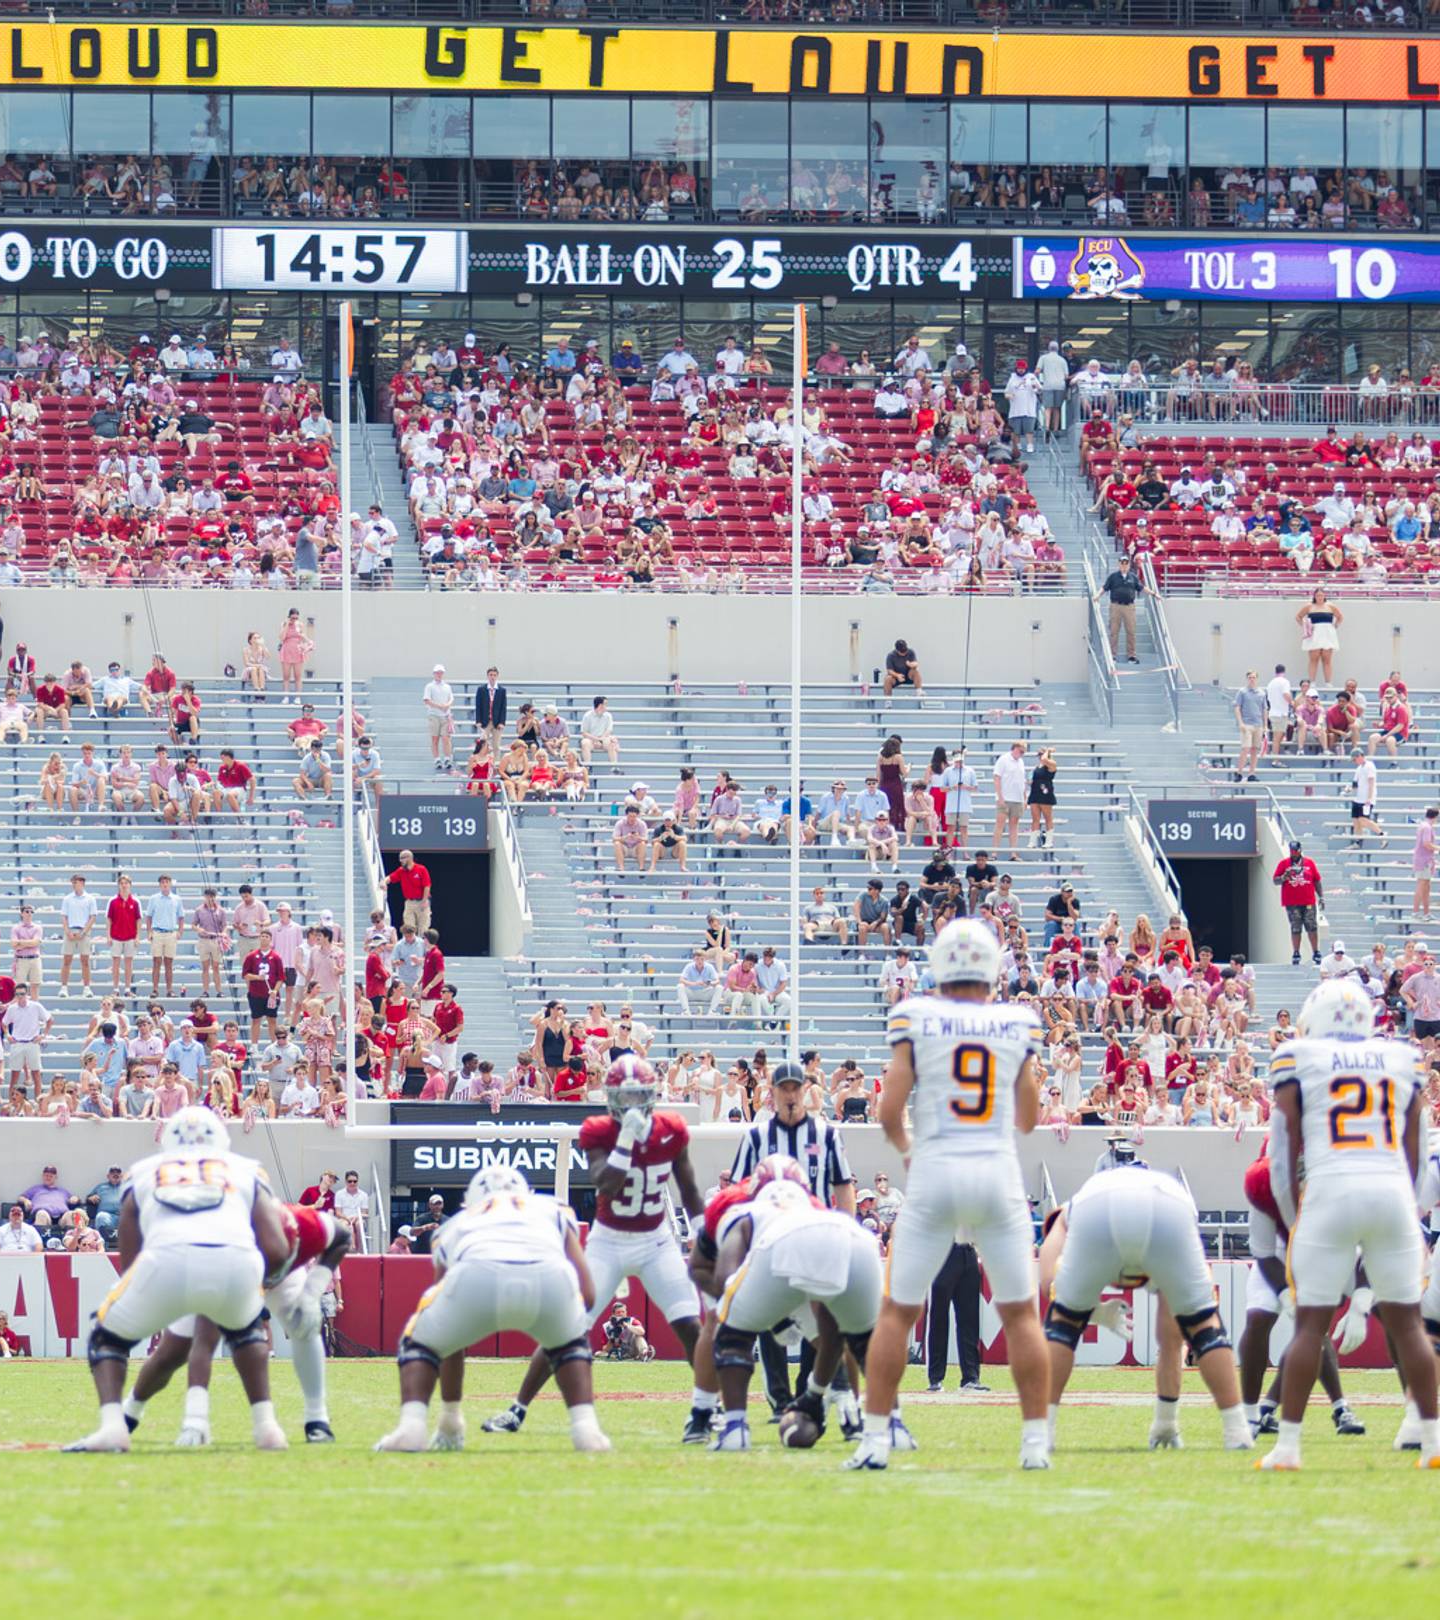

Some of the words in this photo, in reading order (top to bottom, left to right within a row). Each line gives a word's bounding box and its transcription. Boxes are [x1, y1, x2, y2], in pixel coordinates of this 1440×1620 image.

[11, 28, 219, 79] LOUD
[424, 27, 620, 88] GET
[713, 31, 984, 95] LOUD
[1189, 45, 1335, 95] GET
[46, 238, 97, 279] TO
[114, 238, 168, 279] GO
[255, 233, 427, 284] 14:57
[525, 243, 622, 285] BALL
[633, 244, 686, 286] ON
[711, 239, 784, 290] 25
[1088, 240, 1113, 252] ECU
[846, 243, 923, 292] QTR
[938, 242, 978, 291] 4
[1183, 252, 1246, 290] TOL
[1250, 251, 1276, 289] 3
[1327, 248, 1397, 299] 10
[389, 817, 423, 836] 138
[418, 805, 448, 814] SECTION
[443, 818, 477, 836] 139
[1187, 810, 1218, 818] SECTION
[1159, 822, 1192, 841] 139
[1212, 822, 1246, 841] 140
[1332, 1052, 1385, 1071] ALLEN
[947, 1042, 996, 1125] 9
[1327, 1075, 1397, 1151] 21
[413, 1146, 589, 1171] SUBMARN
[611, 1161, 672, 1218] 35
